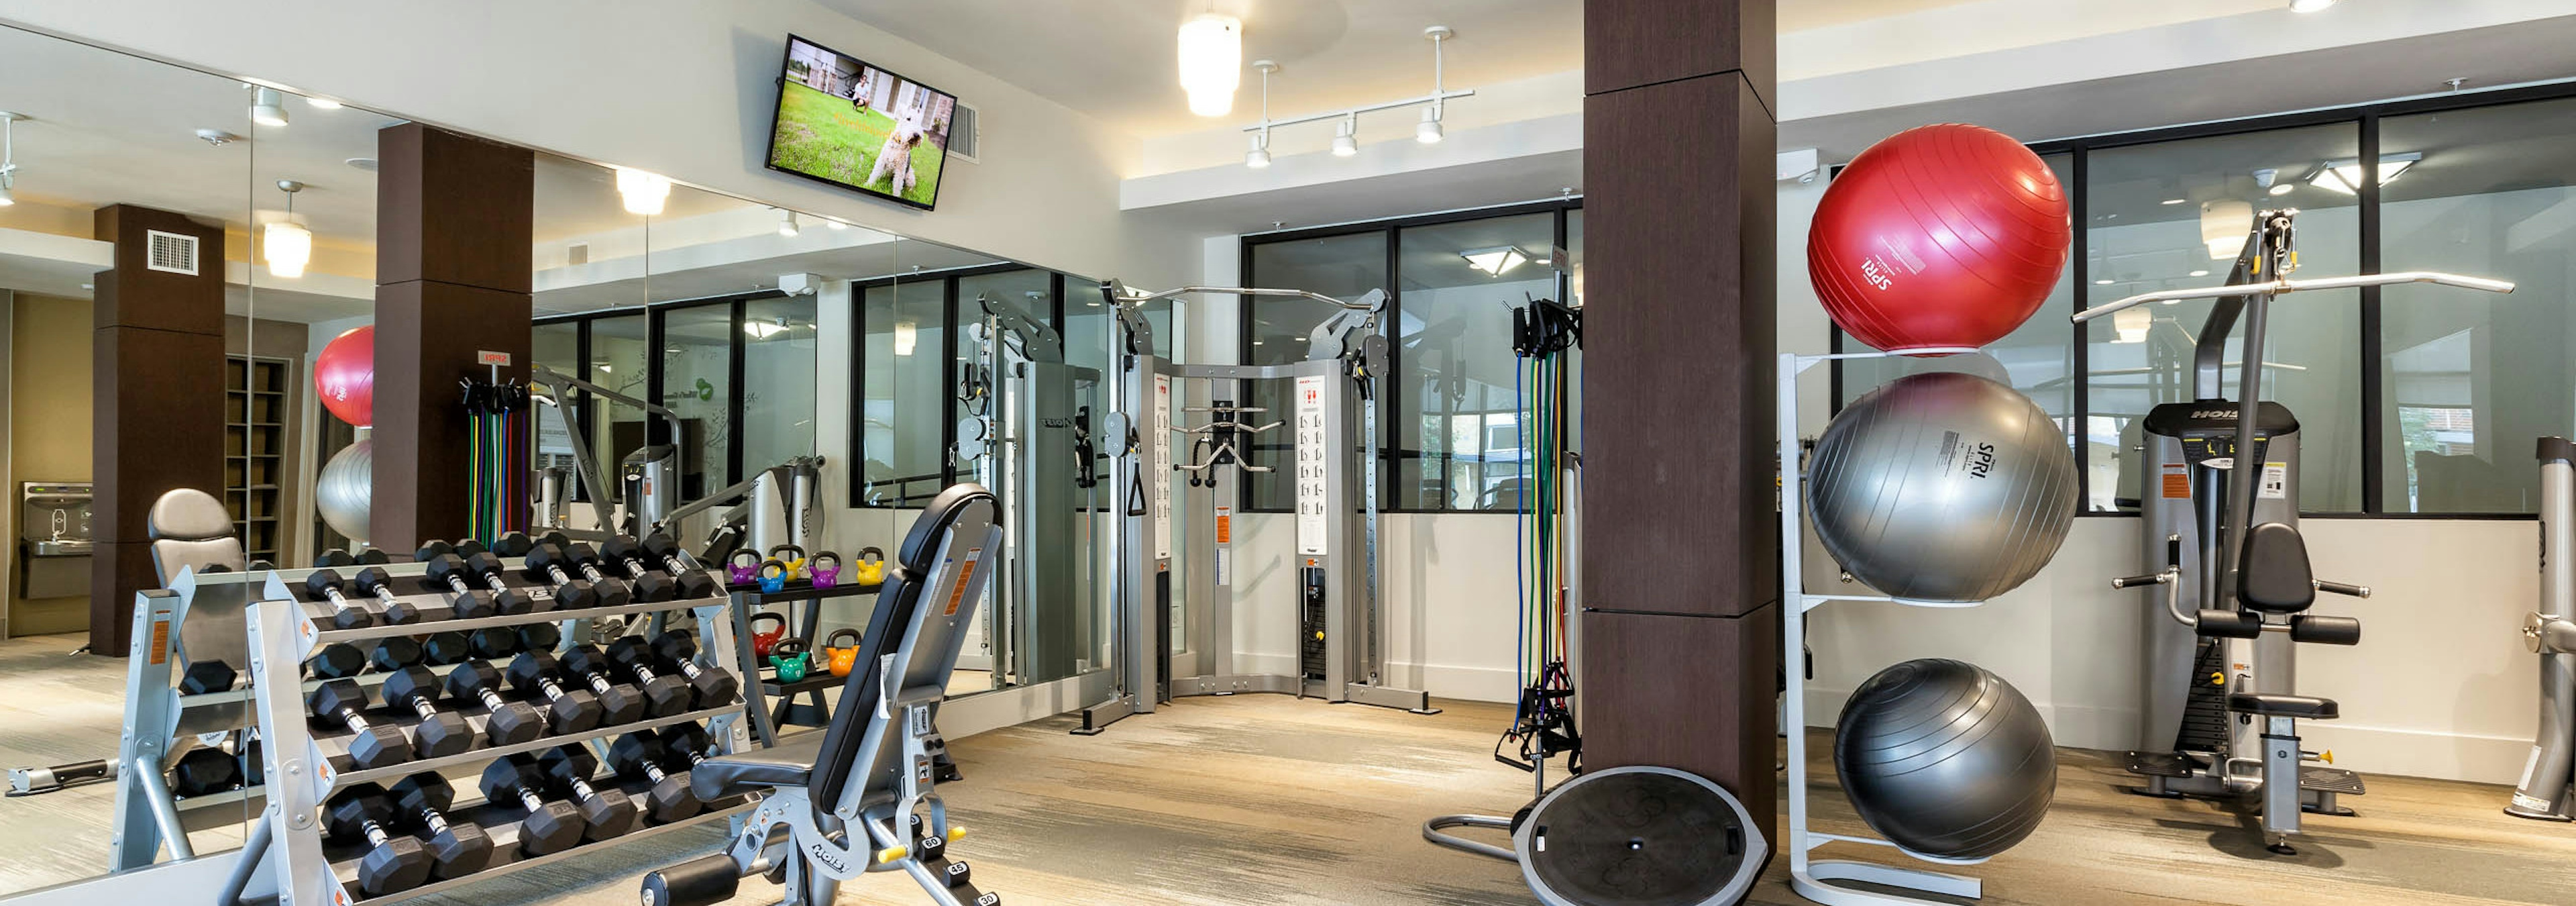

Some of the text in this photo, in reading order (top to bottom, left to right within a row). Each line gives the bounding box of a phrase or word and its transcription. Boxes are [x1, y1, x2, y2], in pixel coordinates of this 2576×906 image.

[1861, 259, 1892, 291] SPRI
[2190, 409, 2239, 419] HOIS
[1972, 442, 1994, 479] SPRI
[925, 838, 938, 847] 60
[812, 844, 851, 874] HOIST
[951, 864, 963, 873] 45
[981, 895, 994, 905] 30
